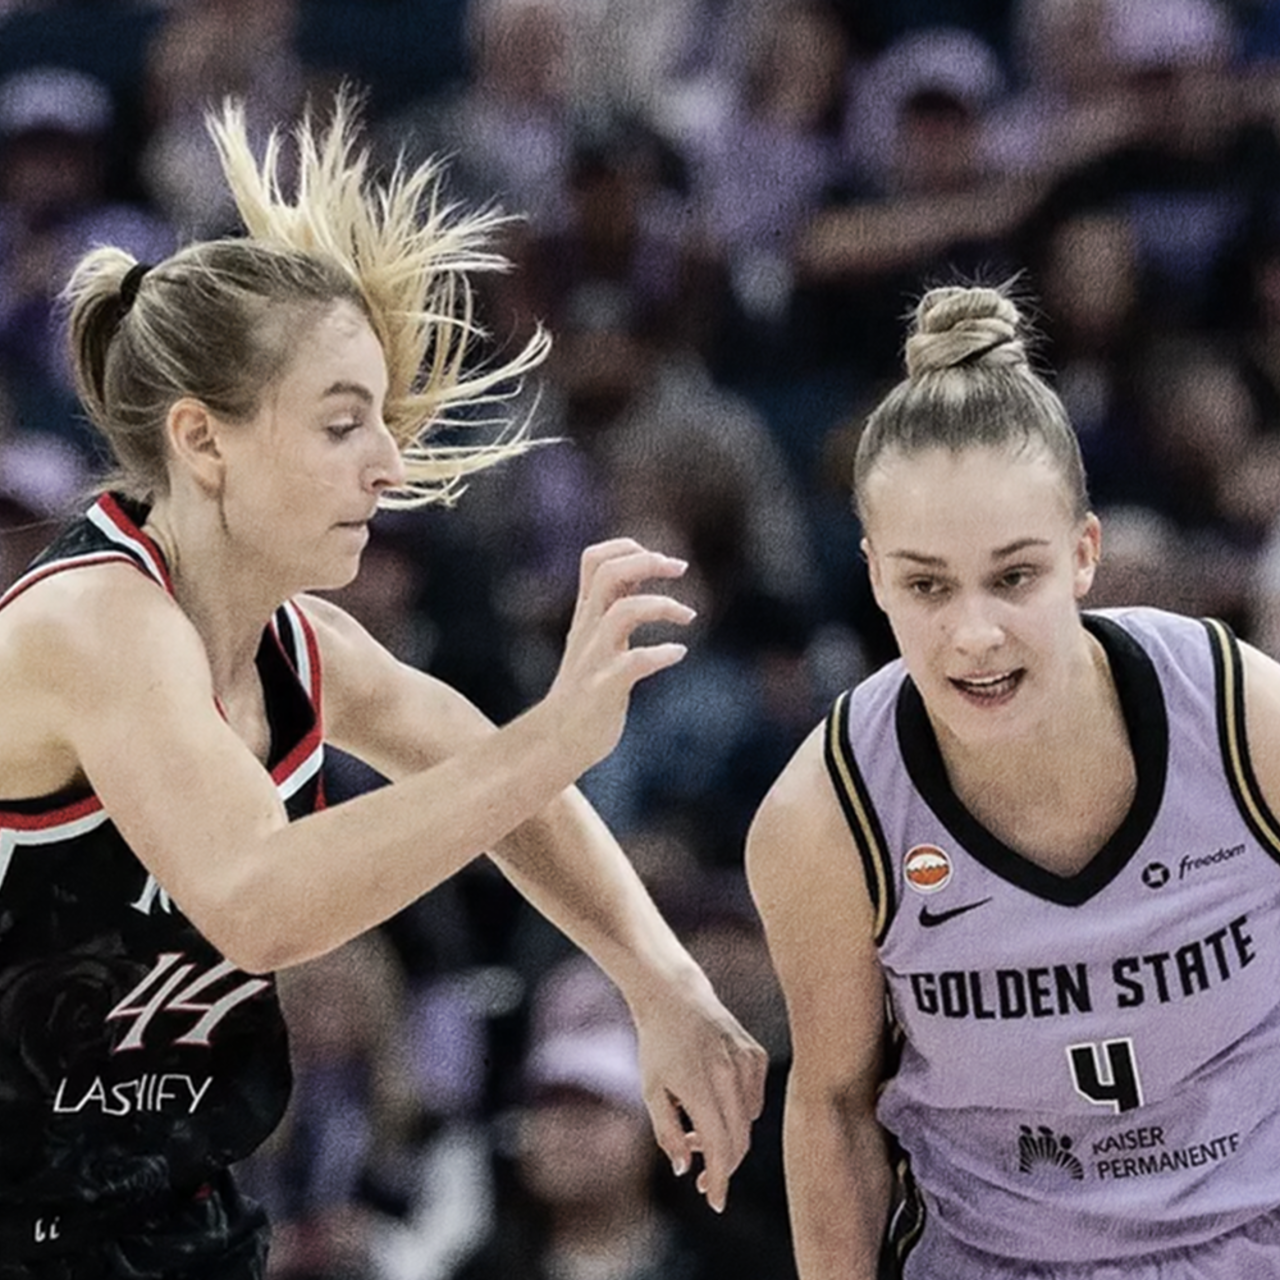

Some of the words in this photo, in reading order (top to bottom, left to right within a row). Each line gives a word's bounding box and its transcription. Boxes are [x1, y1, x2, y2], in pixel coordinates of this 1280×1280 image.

[1179, 843, 1246, 880] freedom
[909, 962, 1093, 1019] GOLDEN
[1112, 914, 1256, 1008] STATE
[104, 951, 270, 1051] 44
[1066, 1037, 1144, 1115] 4
[1091, 1126, 1166, 1155] KAISER
[1096, 1132, 1240, 1180] PERMANENTE
